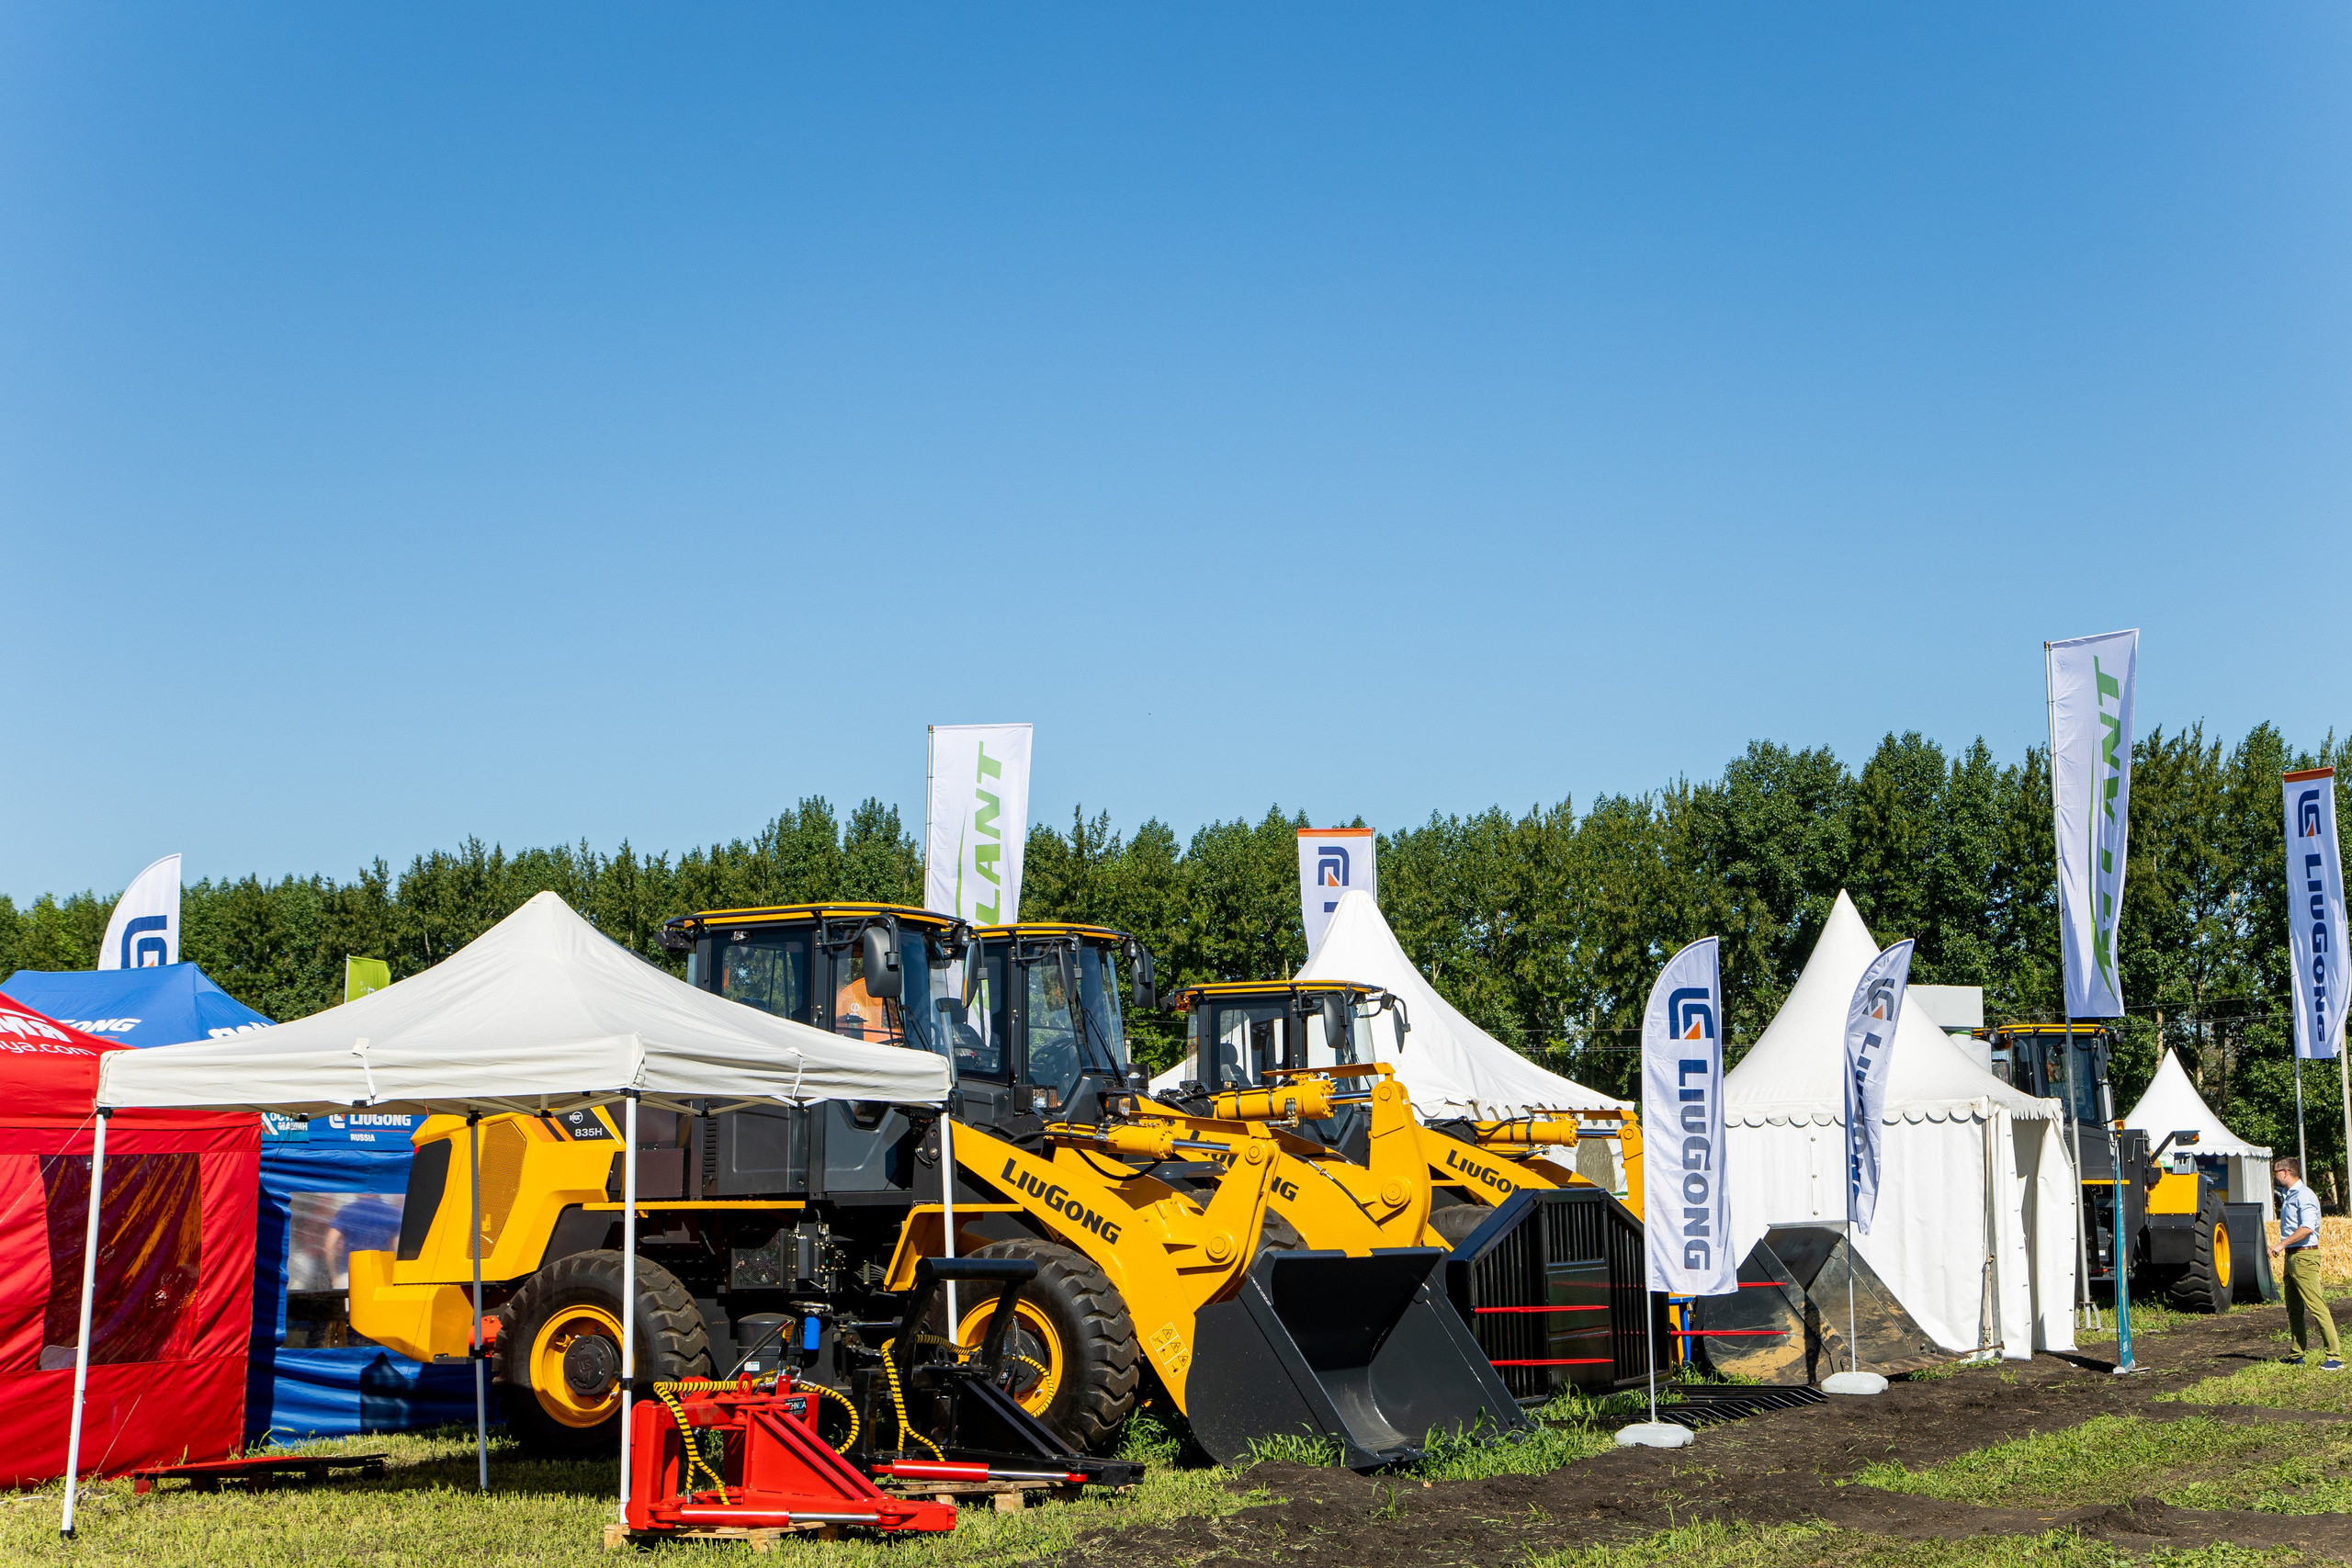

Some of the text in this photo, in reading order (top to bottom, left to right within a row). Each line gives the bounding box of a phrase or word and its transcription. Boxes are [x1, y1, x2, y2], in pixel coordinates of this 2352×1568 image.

[2304, 852, 2328, 1043] LIUGONG
[349, 1113, 412, 1126] LIUGONG
[350, 1133, 376, 1142] RUSSIA
[574, 1127, 603, 1137] 835H
[1678, 1059, 1713, 1270] LIUGONG
